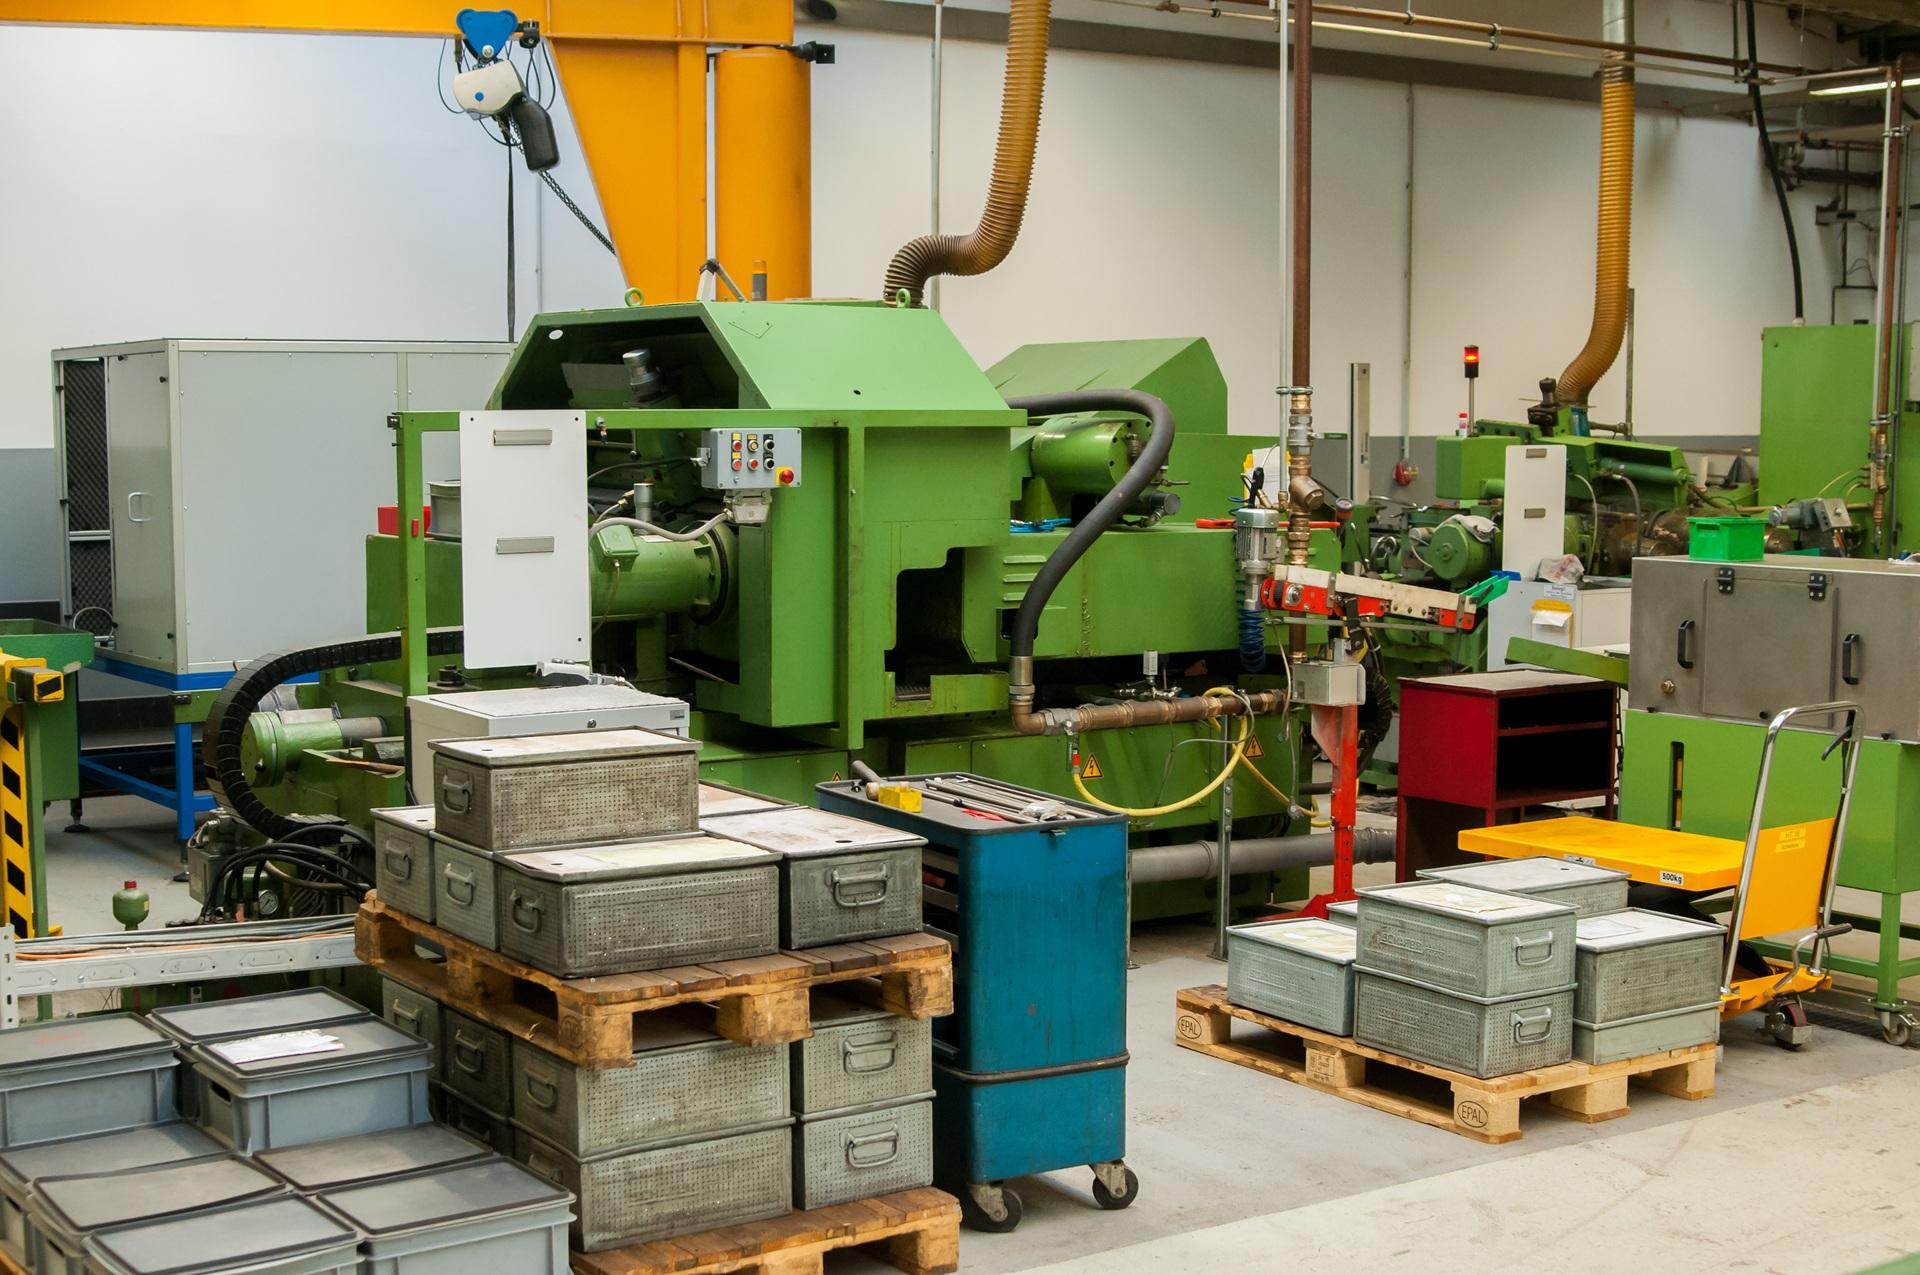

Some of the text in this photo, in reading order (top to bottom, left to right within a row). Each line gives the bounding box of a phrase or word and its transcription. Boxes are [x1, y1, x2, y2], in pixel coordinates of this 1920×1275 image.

[1662, 872, 1682, 884] 500kg
[1181, 1019, 1198, 1036] EPAL
[1461, 1105, 1484, 1124] EPAL
